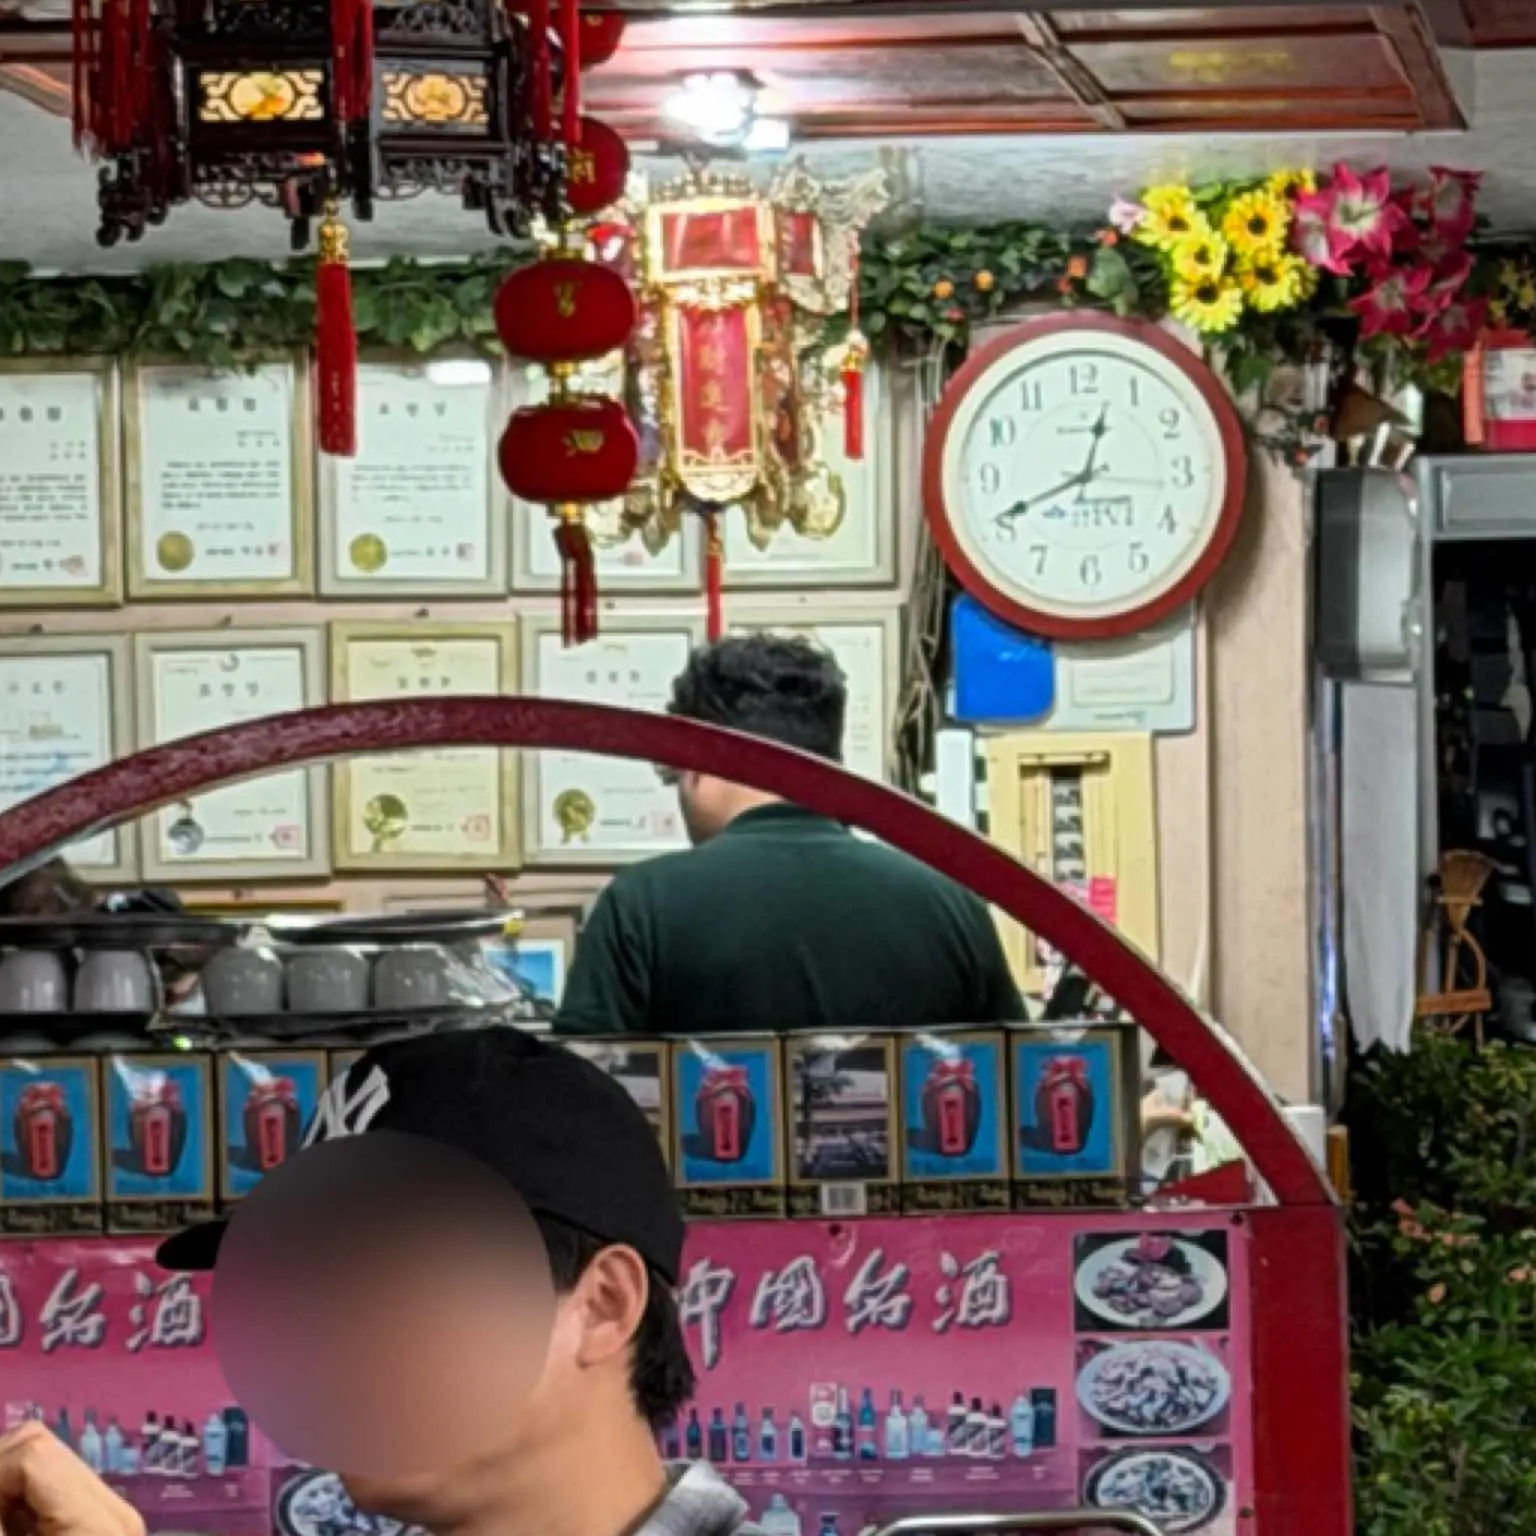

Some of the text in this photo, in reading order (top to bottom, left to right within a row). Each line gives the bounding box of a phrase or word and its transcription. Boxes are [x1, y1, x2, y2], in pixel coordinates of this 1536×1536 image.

[1069, 363, 1099, 394] 12
[1021, 380, 1042, 411] 11
[989, 414, 1015, 447] 10
[1159, 407, 1180, 440] 2
[980, 462, 1000, 495] 9
[1171, 455, 1195, 489] 3
[1157, 504, 1177, 534] 4
[1029, 544, 1047, 575] 7
[1080, 554, 1101, 585] 6
[1128, 542, 1149, 573] 5
